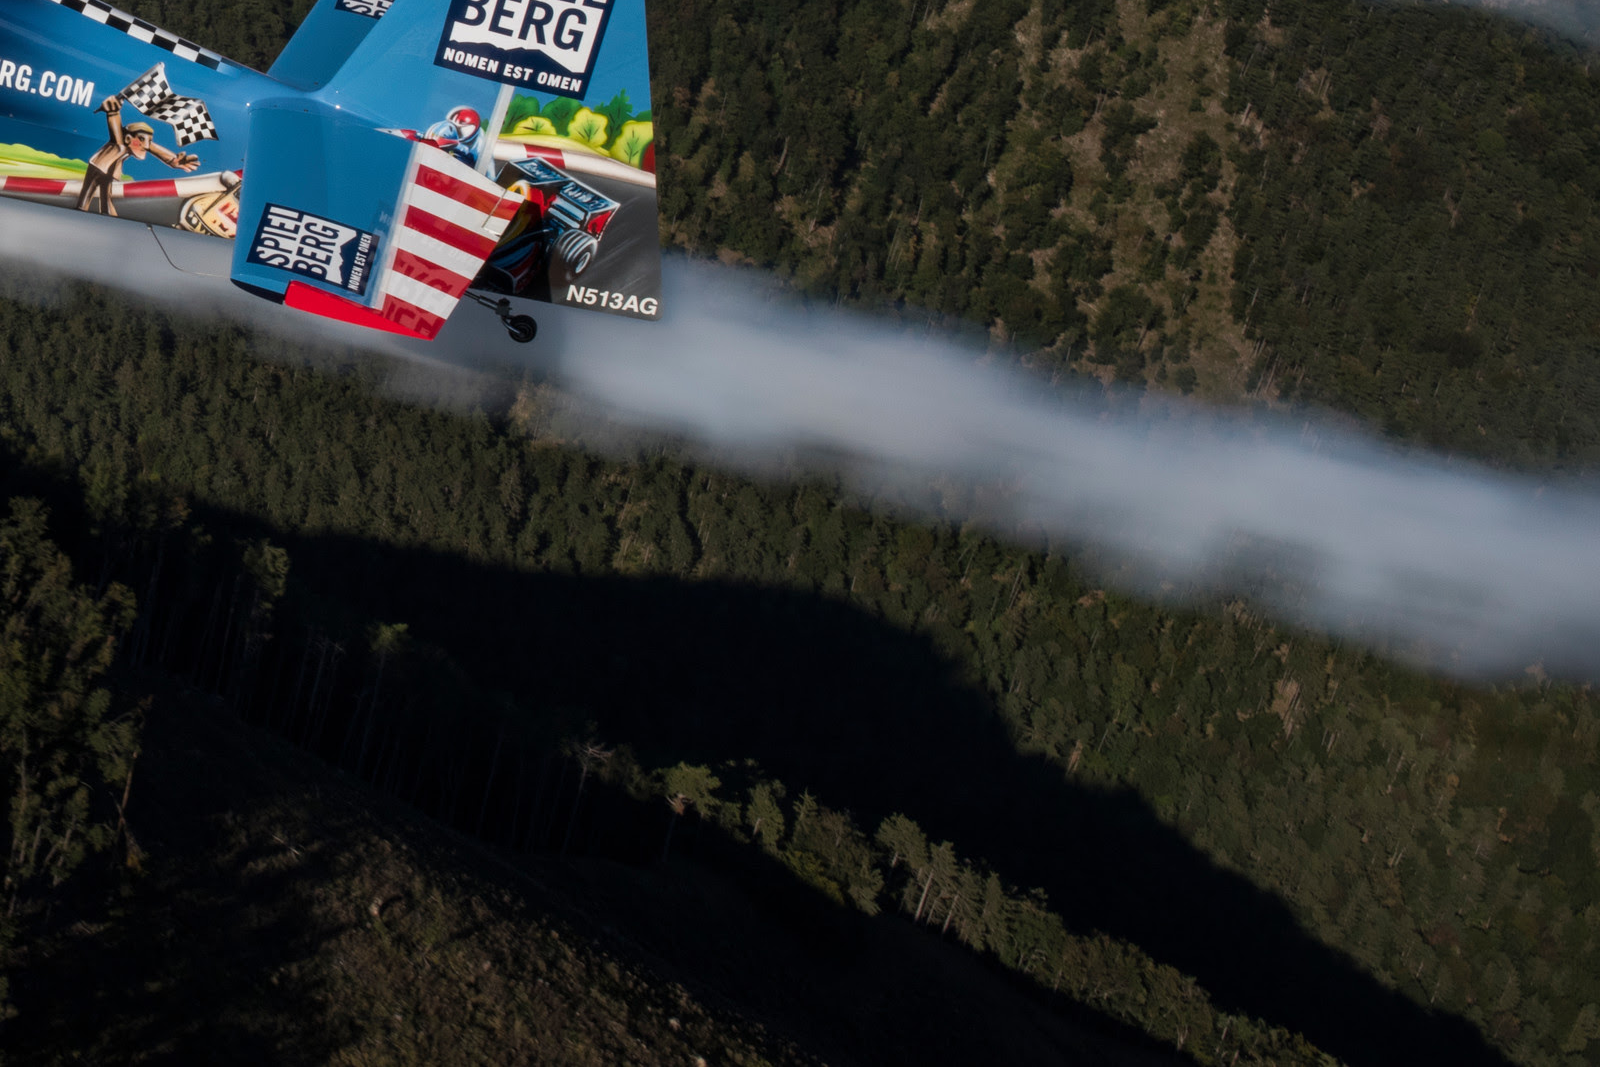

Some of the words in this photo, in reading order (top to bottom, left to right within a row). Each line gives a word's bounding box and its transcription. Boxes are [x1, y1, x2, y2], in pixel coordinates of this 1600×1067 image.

[443, 47, 499, 73] NOMEN
[502, 64, 533, 81] EST
[536, 72, 582, 92] OMEN
[257, 210, 302, 268] SPIEL
[291, 222, 340, 280] BERG
[358, 233, 372, 253] OMEN
[354, 252, 367, 266] EST
[347, 265, 363, 291] NOMEN
[566, 285, 658, 316] N513AG
